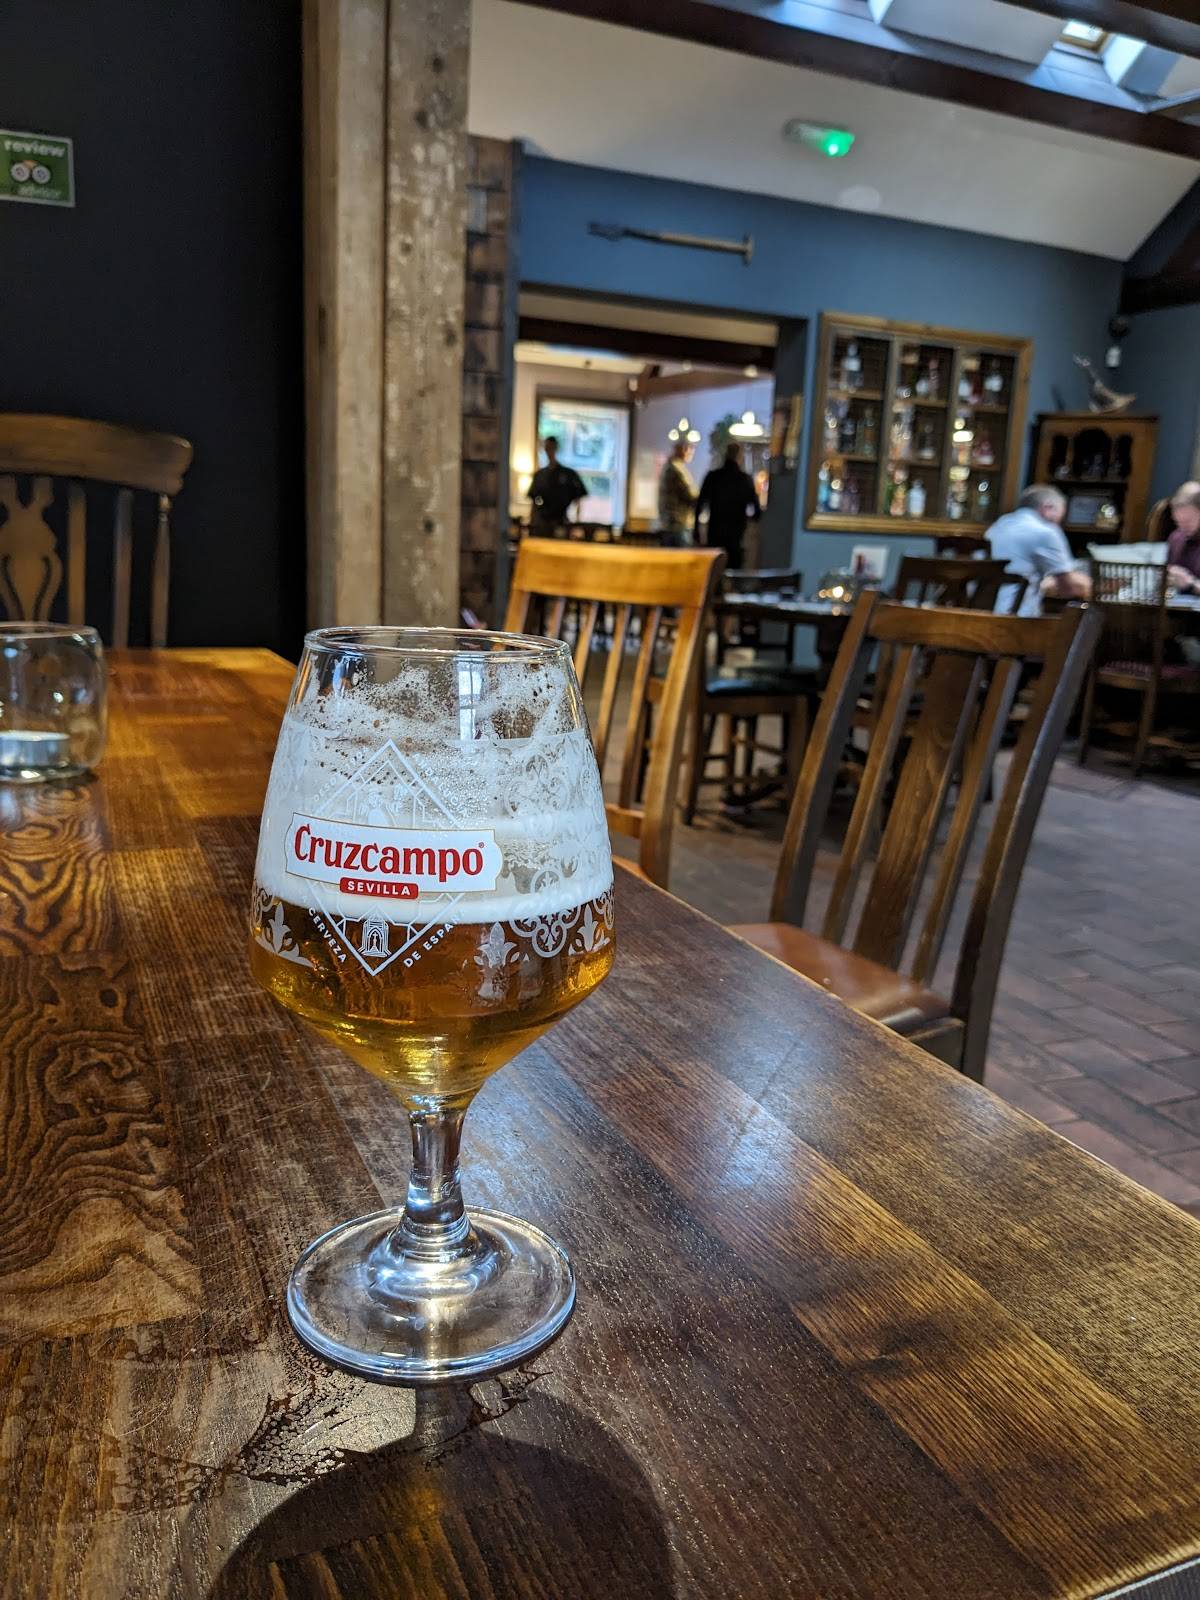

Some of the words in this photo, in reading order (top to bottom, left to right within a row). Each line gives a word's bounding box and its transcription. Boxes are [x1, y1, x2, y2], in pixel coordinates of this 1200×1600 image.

[347, 881, 411, 896] SEVILLA
[308, 907, 347, 963] CERVEZA
[403, 950, 421, 968] DE
